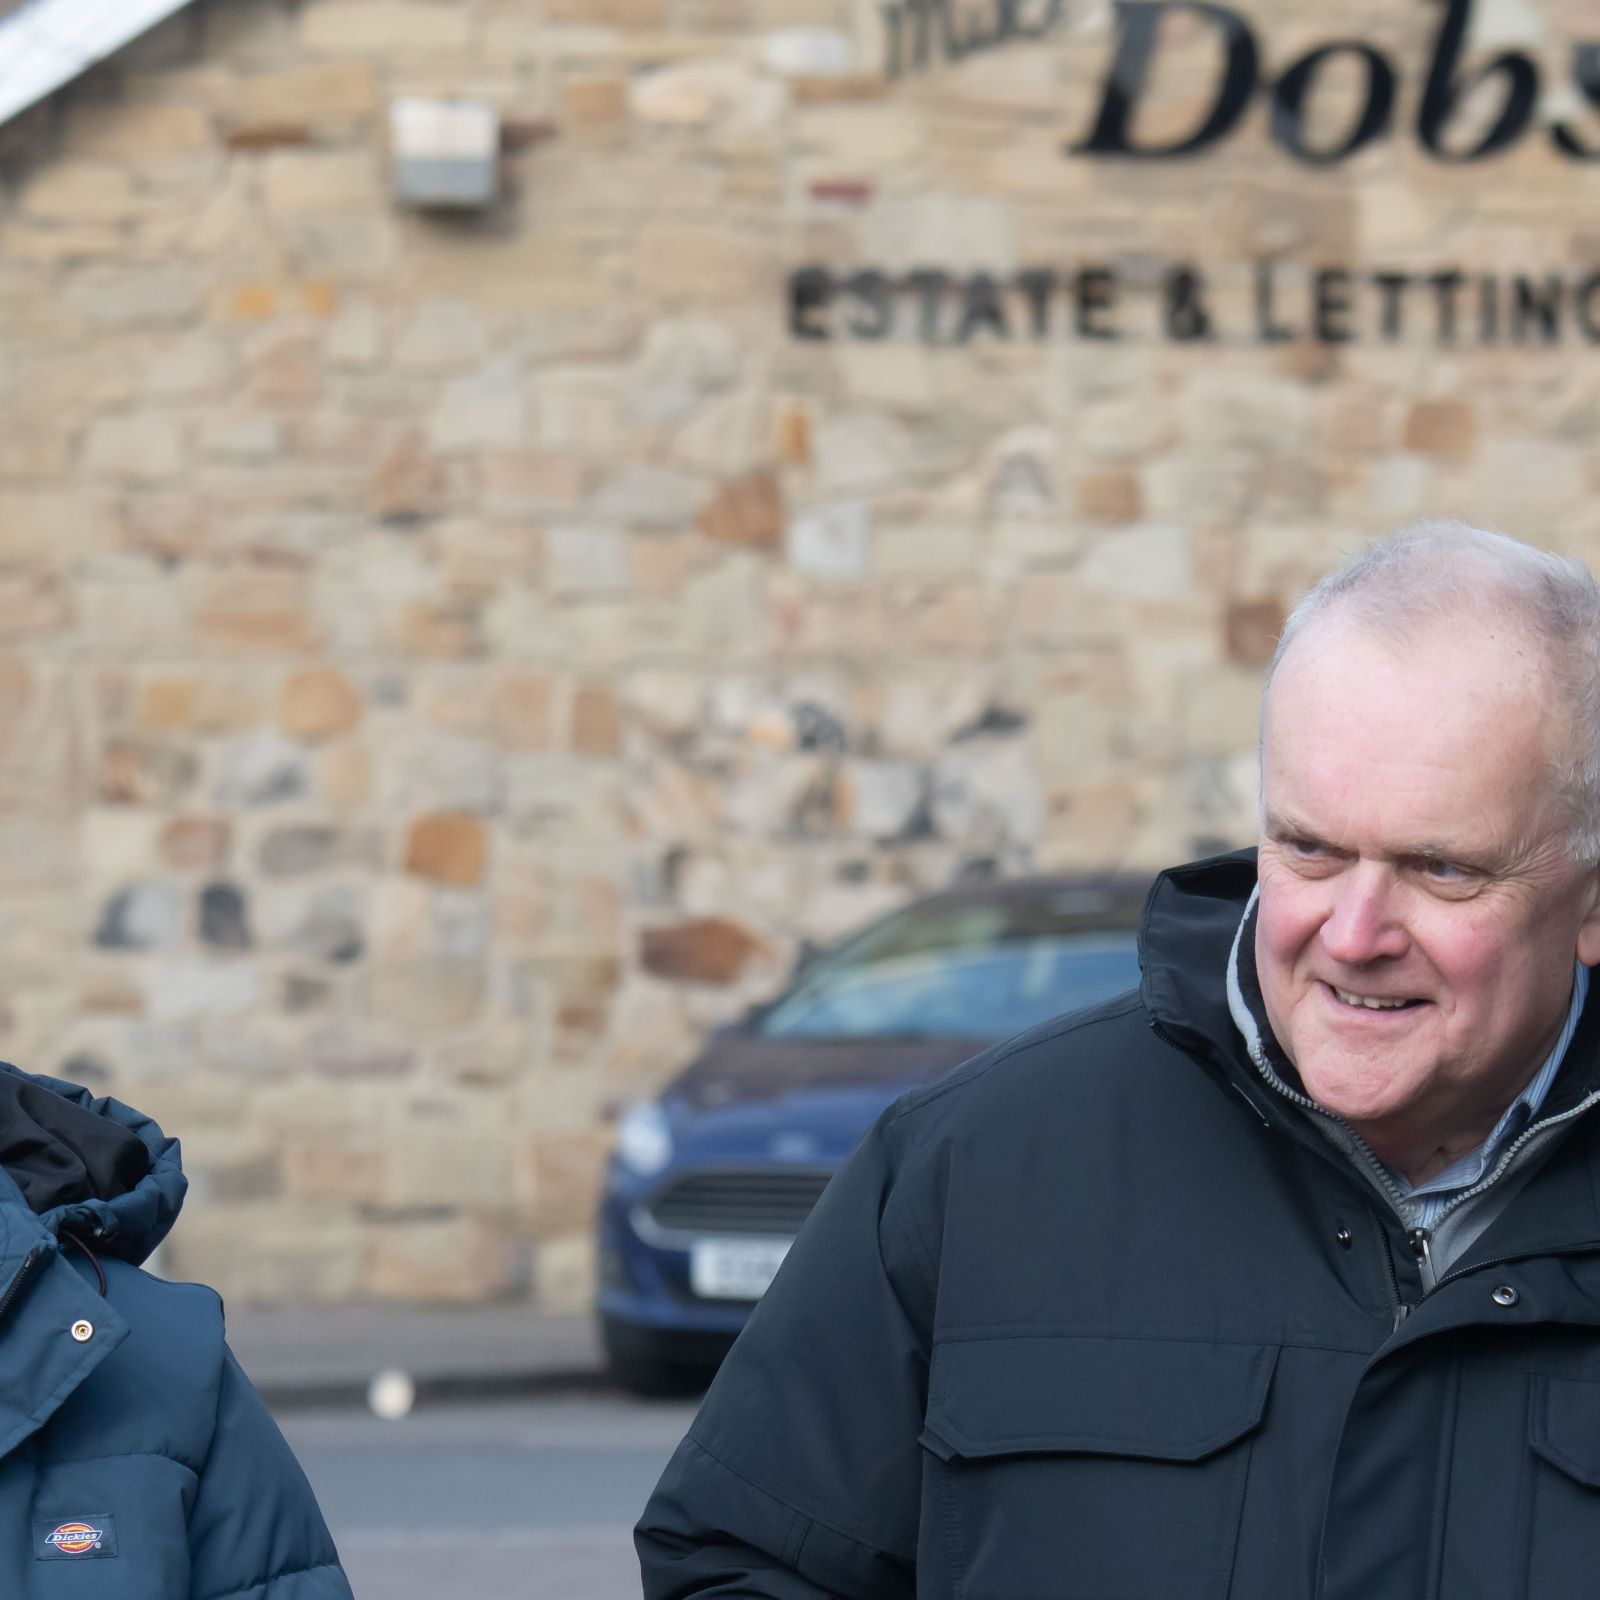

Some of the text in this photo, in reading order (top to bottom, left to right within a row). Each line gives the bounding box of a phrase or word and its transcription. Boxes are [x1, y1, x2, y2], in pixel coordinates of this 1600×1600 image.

[788, 266, 1126, 342] ESTATE
[1162, 263, 1212, 342] &
[51, 1532, 98, 1542] Dickies
